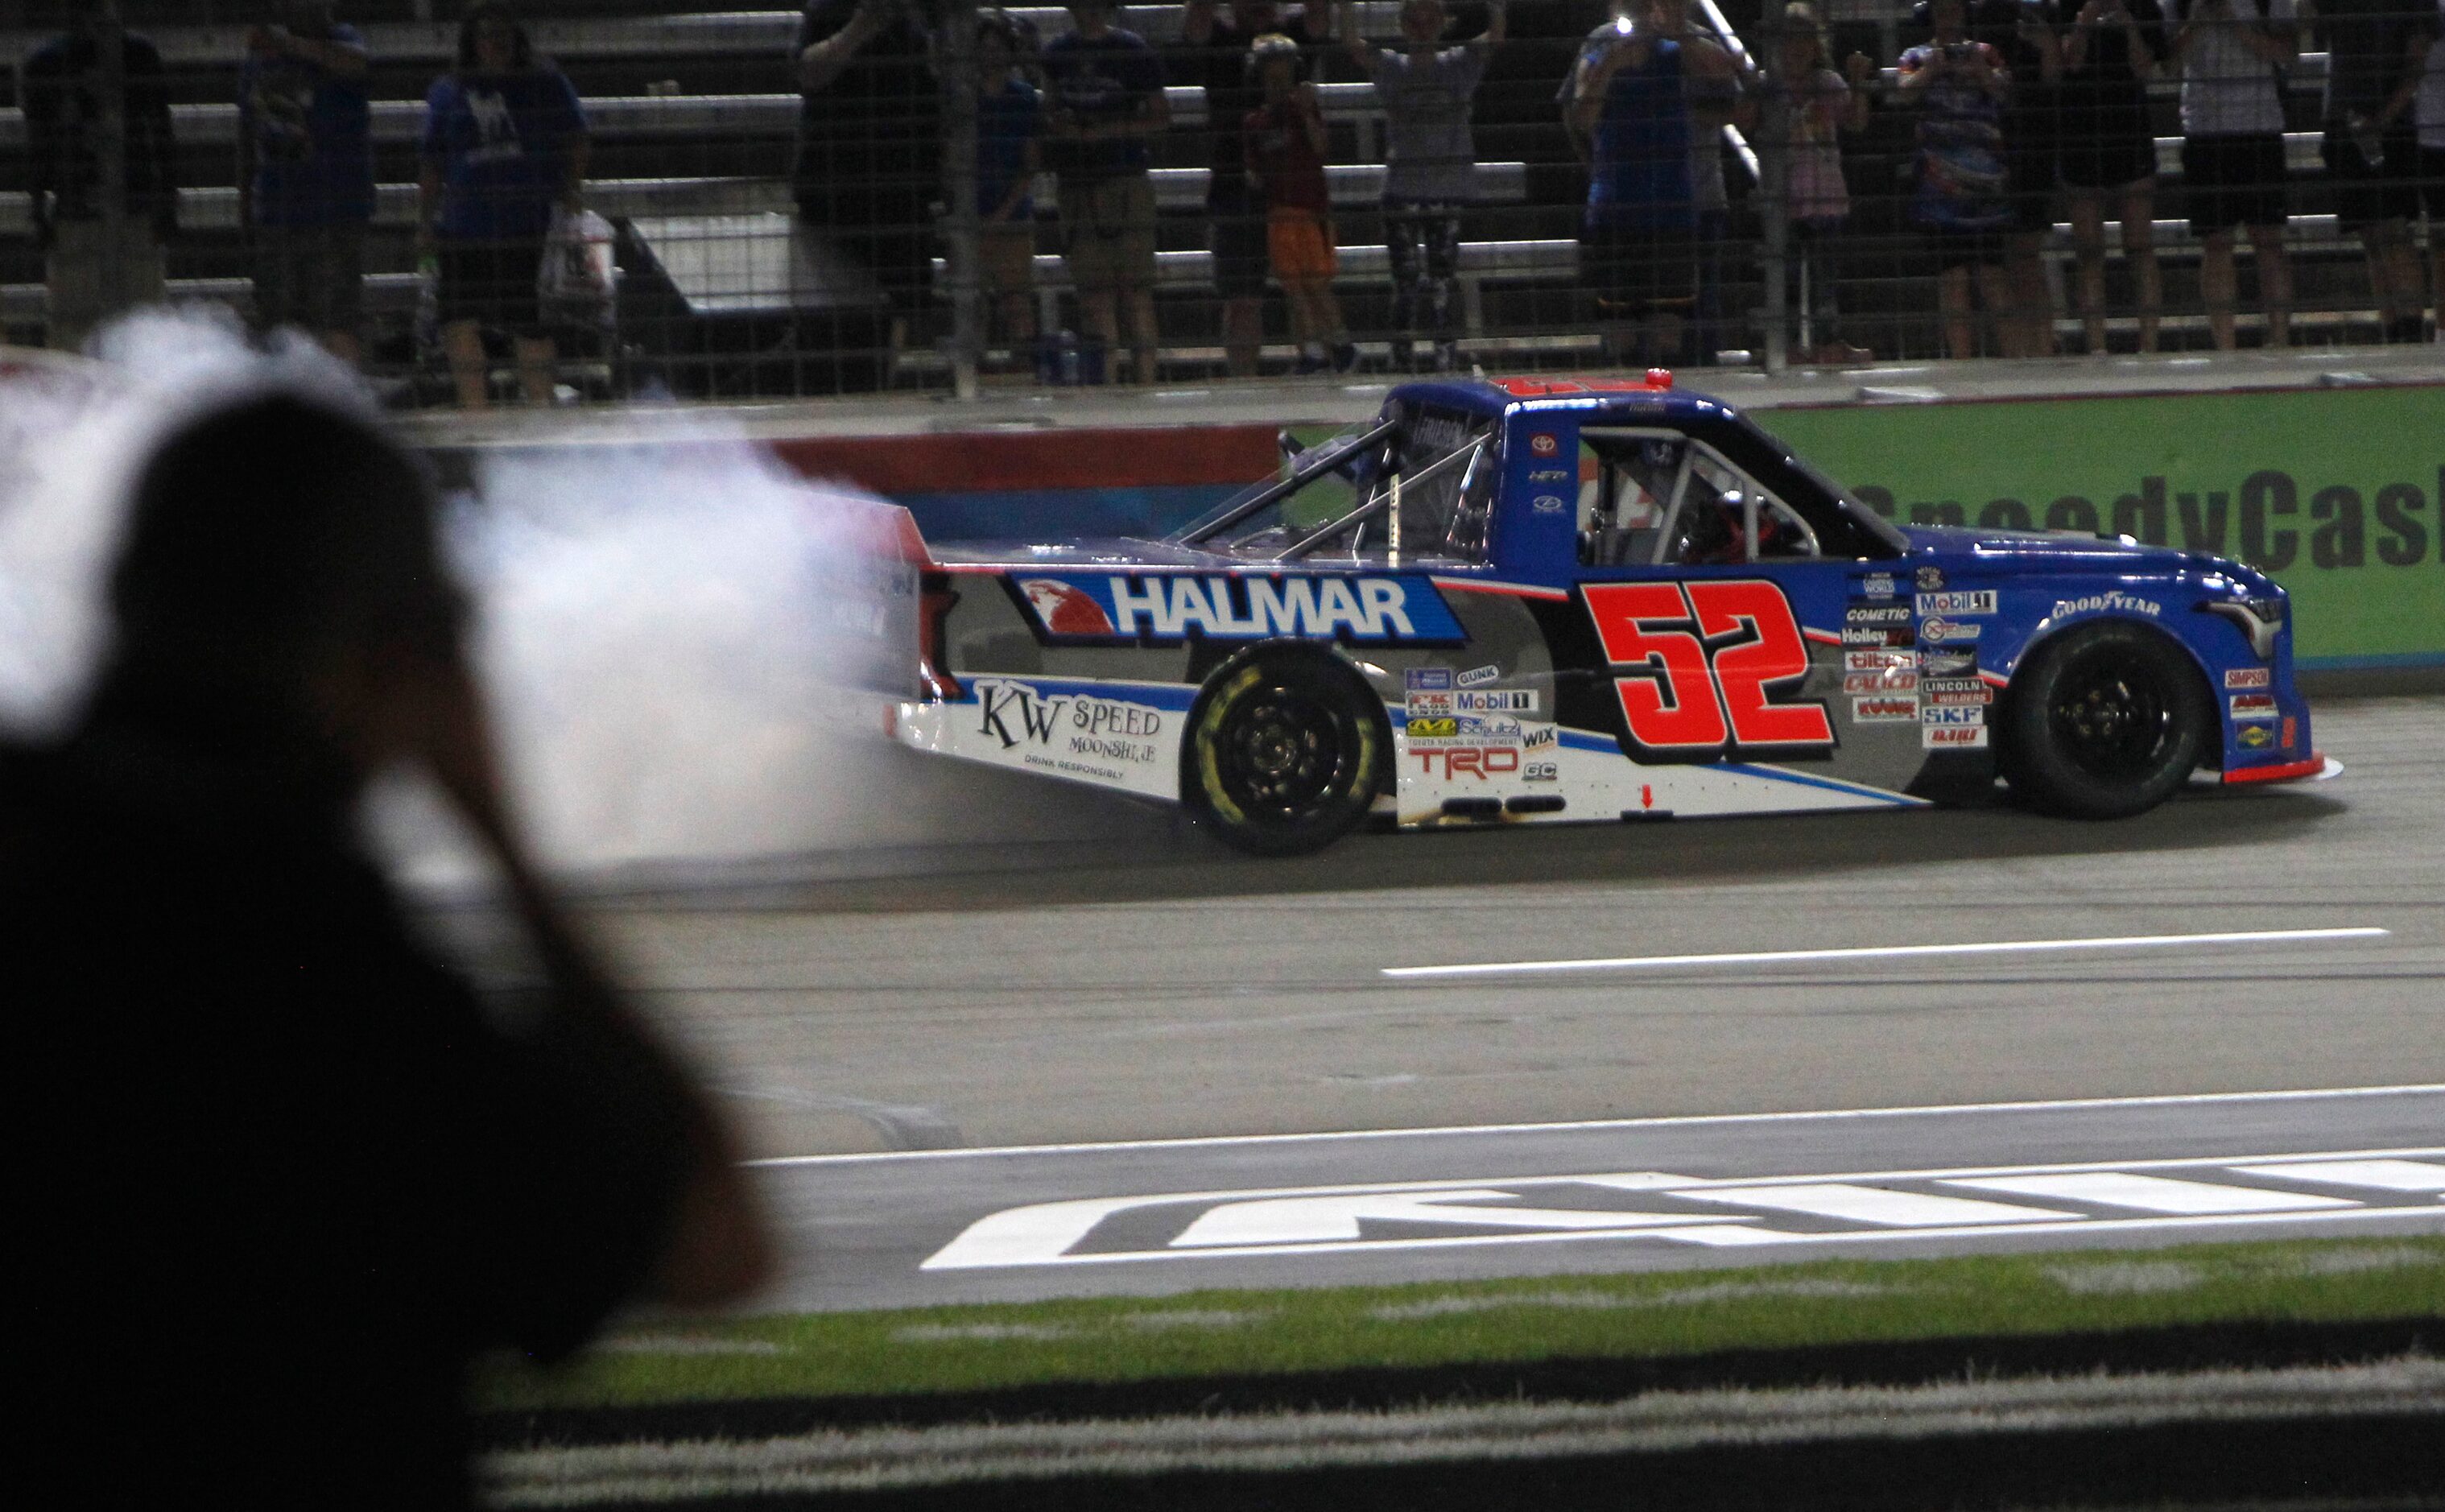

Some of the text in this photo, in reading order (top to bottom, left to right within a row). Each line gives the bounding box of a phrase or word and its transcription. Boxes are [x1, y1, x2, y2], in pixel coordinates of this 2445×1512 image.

[1850, 465, 2445, 572] edyCas
[1109, 576, 1416, 635] HALMAR
[1921, 593, 1971, 610] Mobil
[2052, 590, 2162, 620] GOODYEAR
[1846, 607, 1910, 622] COMETIC
[1841, 627, 1888, 645] Holley
[1580, 580, 1834, 747] 52
[1459, 666, 1496, 684] GUNK
[1844, 675, 1917, 691] CALICO
[2228, 669, 2269, 686] SIMPSON
[1925, 680, 1980, 692] LINCOLN
[1457, 691, 1509, 709] Mobil
[1938, 692, 1987, 704] WELDERS
[977, 685, 1067, 750] KW
[1072, 699, 1161, 736] SPEED
[1924, 707, 1982, 724] SKF
[1522, 727, 1555, 749] WIX
[1024, 754, 1124, 779] DRINK RESPONSIBLY
[1408, 746, 1518, 781] TRD
